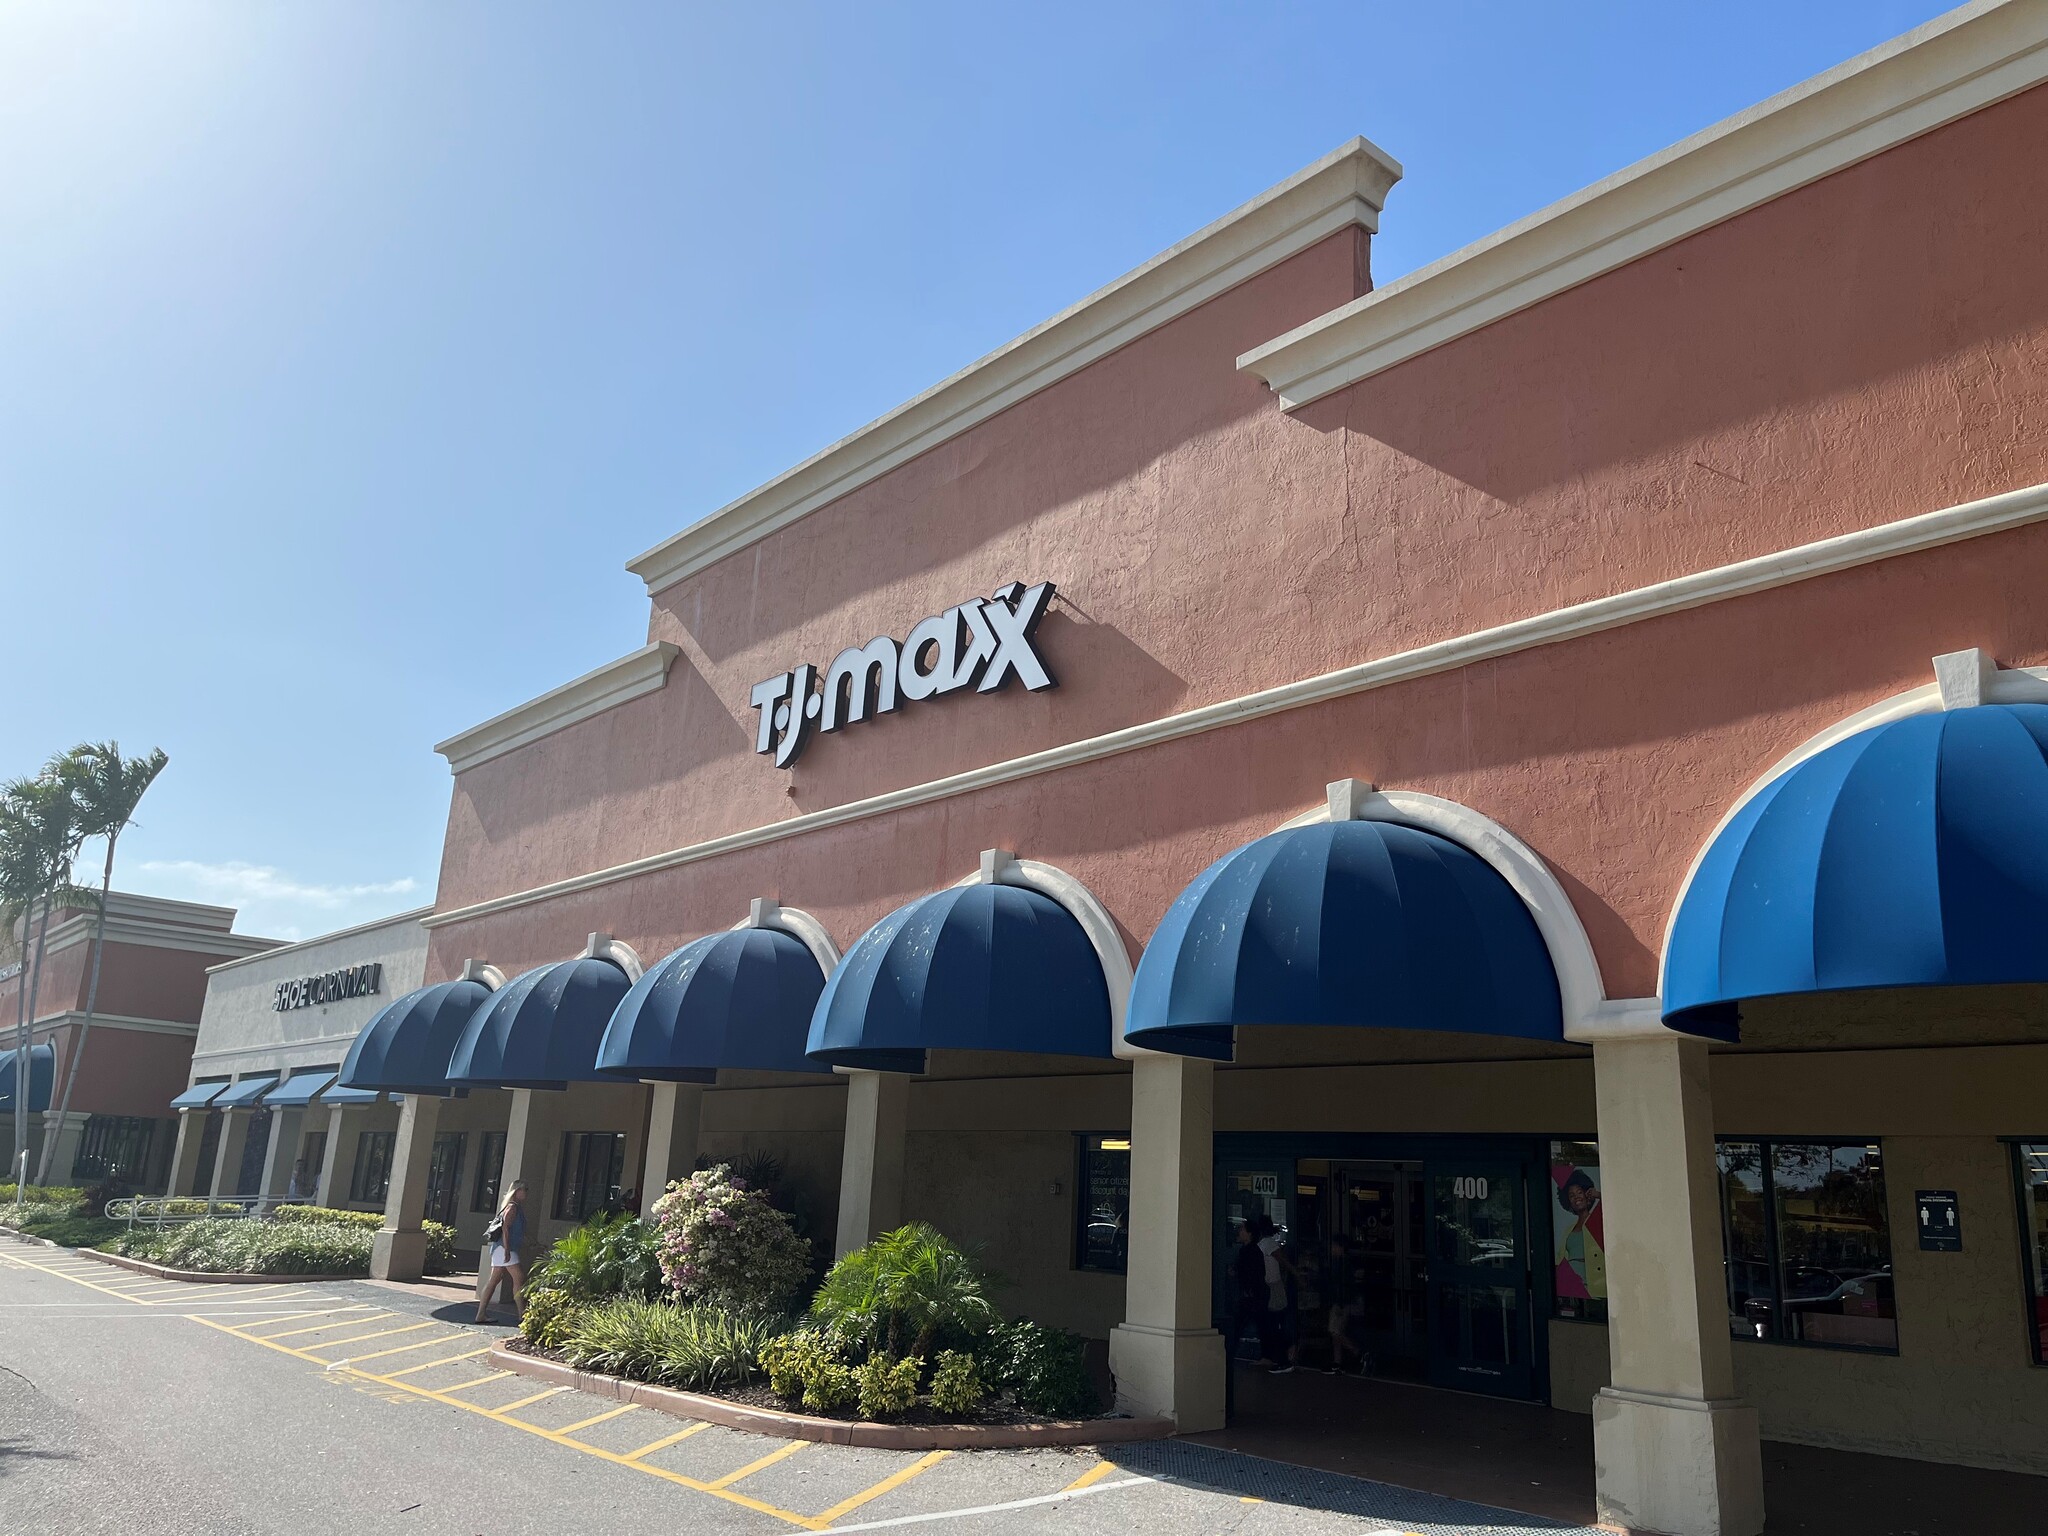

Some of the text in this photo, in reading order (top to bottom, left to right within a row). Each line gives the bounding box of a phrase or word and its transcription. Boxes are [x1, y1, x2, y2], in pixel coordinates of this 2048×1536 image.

[272, 963, 382, 1011] SHOE CARNIVAL
[1255, 1177, 1275, 1192] 400
[1453, 1176, 1488, 1200] 400
